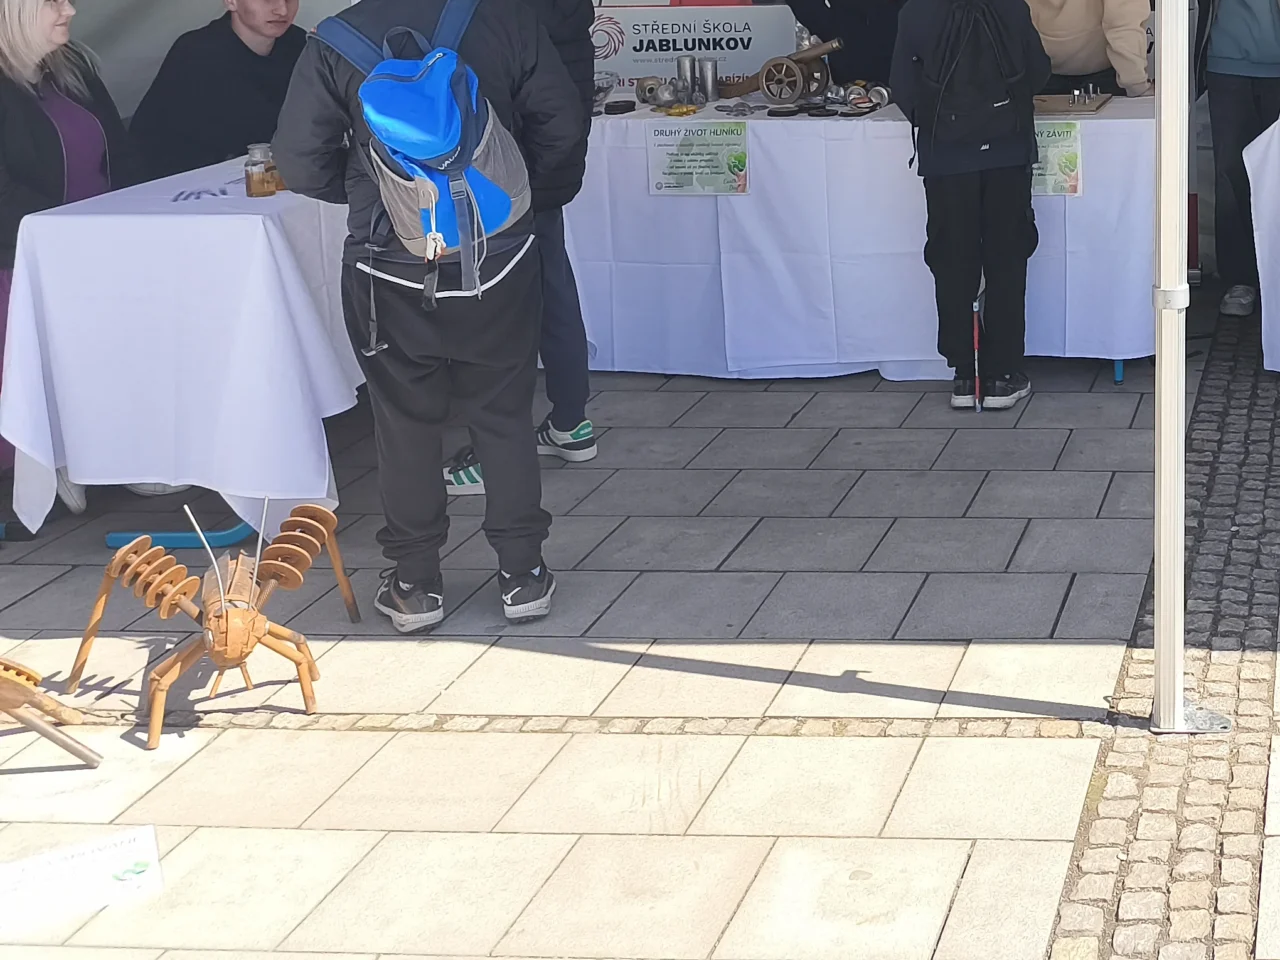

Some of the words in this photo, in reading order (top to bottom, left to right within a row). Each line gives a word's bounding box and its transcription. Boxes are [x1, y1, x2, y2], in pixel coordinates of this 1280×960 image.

[632, 20, 697, 35] STŘEDNÍ
[702, 19, 752, 34] ŠKOLA
[632, 36, 752, 53] JABLUNKOV
[653, 127, 682, 137] DRUHÝ
